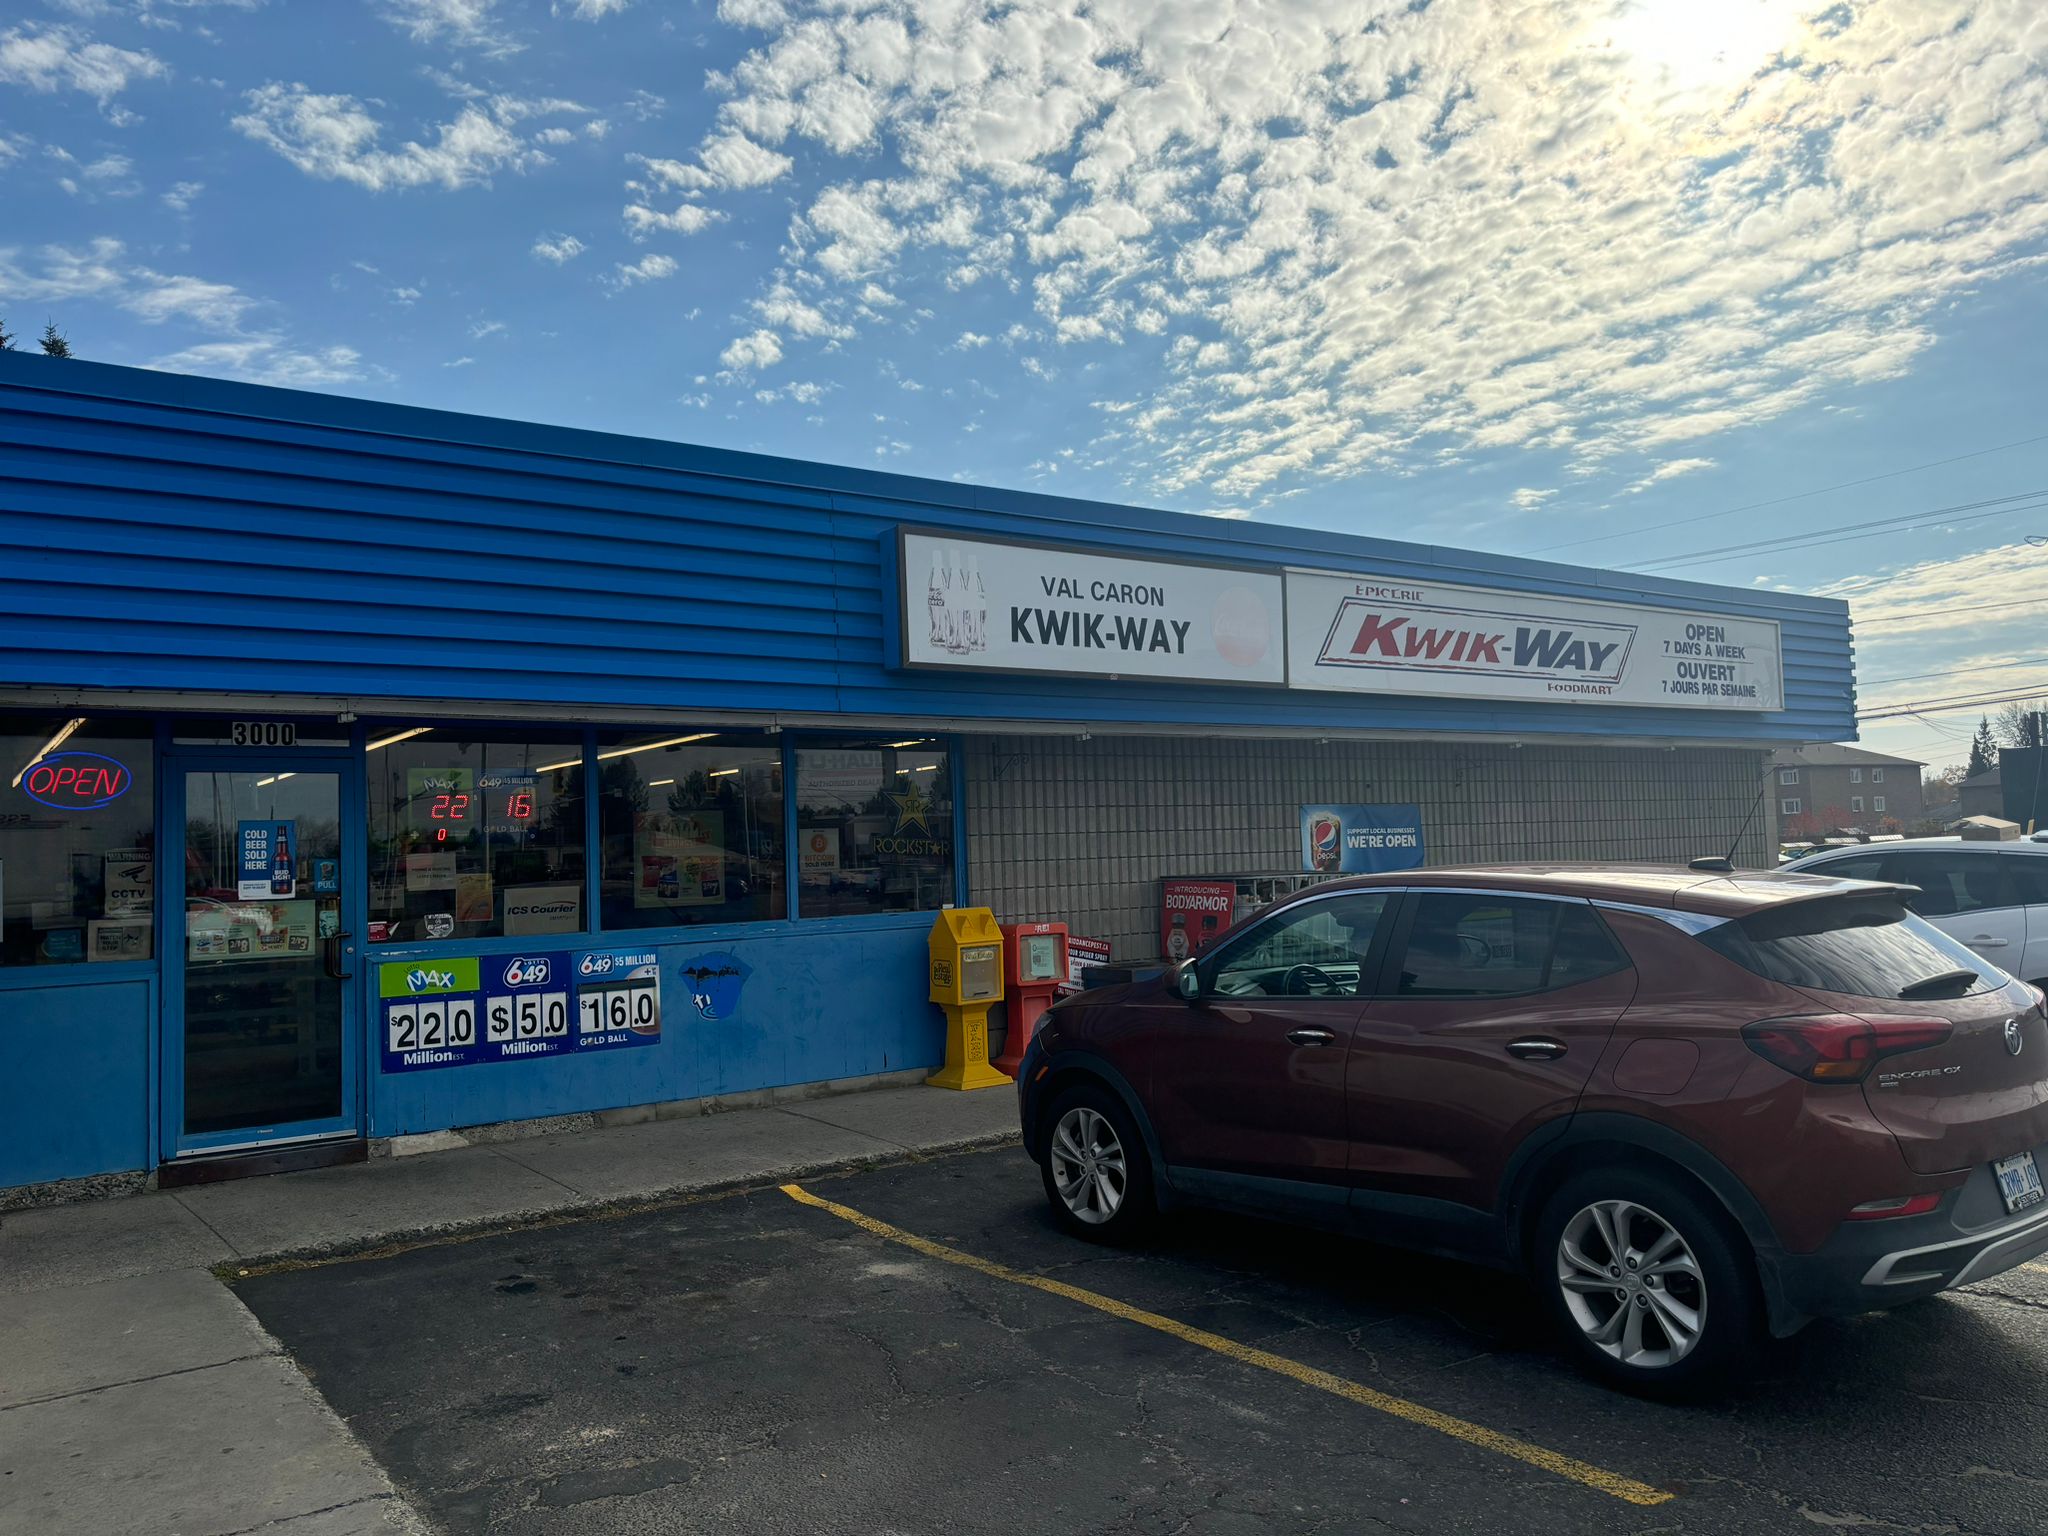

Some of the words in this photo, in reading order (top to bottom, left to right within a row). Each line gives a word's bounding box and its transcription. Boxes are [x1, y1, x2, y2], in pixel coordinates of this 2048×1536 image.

[1040, 576, 1084, 599] VAL
[1090, 581, 1165, 607] CARON
[1010, 606, 1191, 654] KWIK-WAY
[1685, 623, 1725, 642] OPEN
[1663, 640, 1670, 653] 7
[1674, 641, 1701, 655] DAYS
[1705, 644, 1712, 656] A
[1715, 645, 1745, 659] WEEK
[1677, 661, 1736, 681] OUVERT
[1547, 682, 1612, 695] FOODMART
[1662, 680, 1667, 692] 7
[1670, 681, 1699, 694] JOURS
[1702, 683, 1718, 695] PAR
[1720, 684, 1756, 697] SEMAINE
[233, 723, 294, 745] 3000
[29, 767, 122, 796] OPEN
[431, 794, 471, 819] 22
[507, 794, 532, 819] 16
[244, 830, 267, 839] COLD
[437, 828, 447, 841] 0
[1347, 836, 1383, 848] WE'RE
[1386, 835, 1416, 847] OPEN
[245, 840, 267, 849] BEER
[244, 850, 267, 859] SOLD
[804, 854, 835, 862] BITCOIN
[1317, 852, 1337, 860] pepsi
[244, 861, 267, 870] HERE
[317, 881, 336, 889] PULL
[1174, 886, 1220, 894] INTRODUCING
[111, 889, 145, 898] CCTV
[507, 906, 528, 915] ICS
[530, 904, 576, 914] Courier
[1166, 895, 1228, 911] BODYARMOR
[580, 956, 612, 974] 649
[615, 956, 624, 966] $5
[625, 954, 656, 966] MILLION
[506, 960, 547, 985] 649
[407, 969, 453, 992] MAX
[491, 1001, 565, 1036] $5.0
[608, 1034, 628, 1043] BALL
[501, 1041, 547, 1055] Million
[403, 1051, 453, 1065] Million
[1879, 1069, 1941, 1081] ENCORE
[1943, 1065, 1961, 1074] GX
